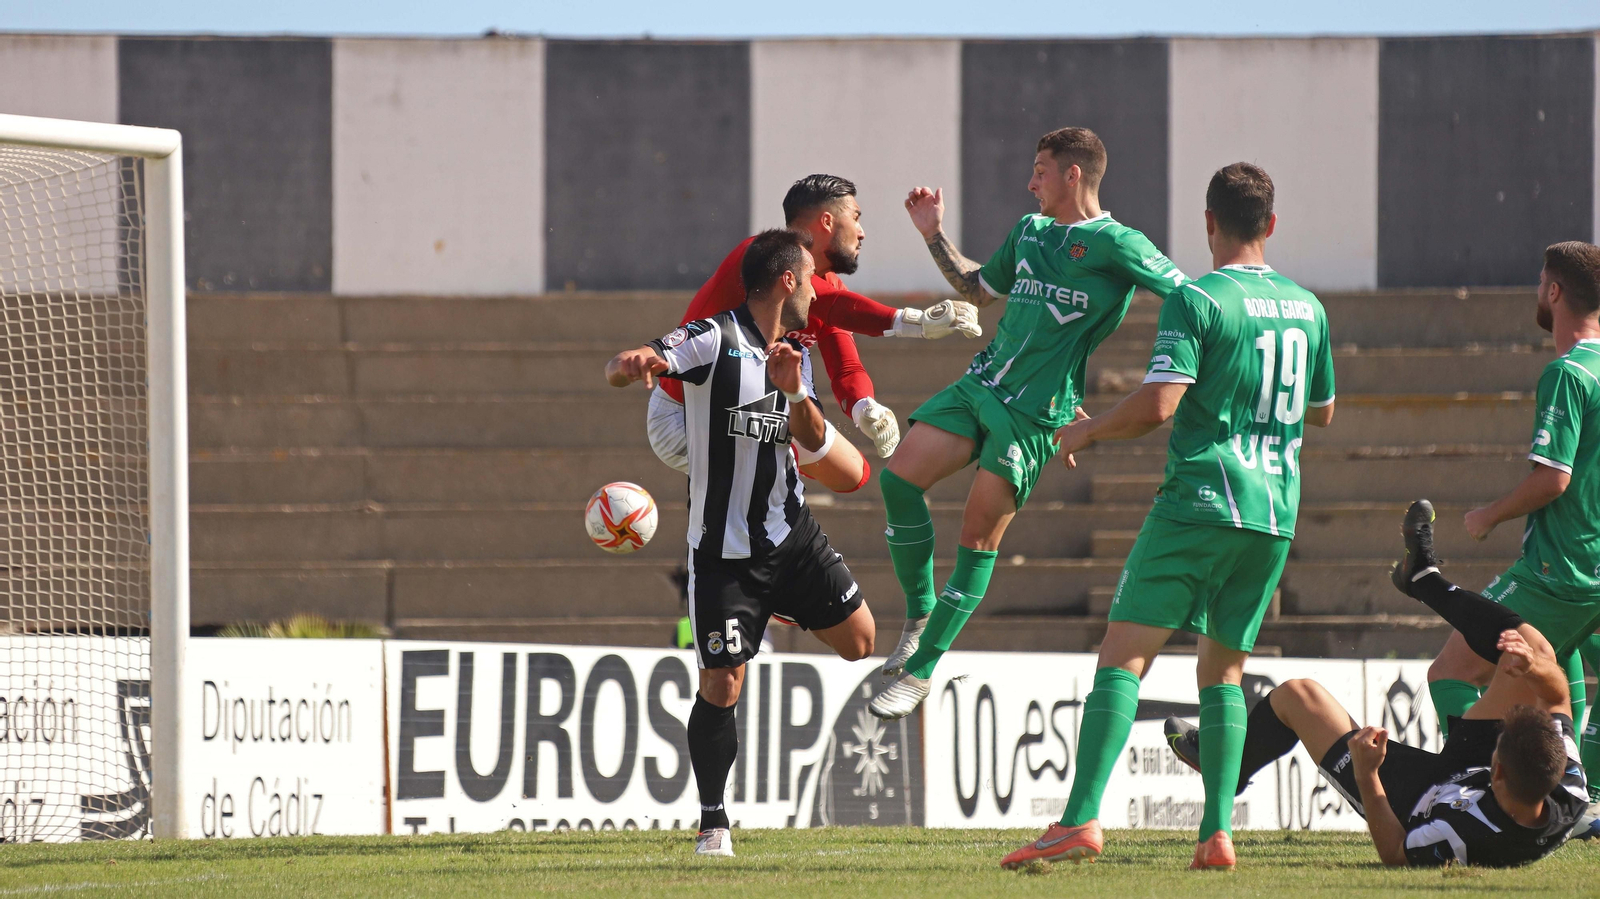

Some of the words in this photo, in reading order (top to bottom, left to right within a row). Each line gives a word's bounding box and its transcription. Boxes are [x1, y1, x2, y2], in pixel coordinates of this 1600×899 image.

[1243, 297, 1280, 319] BORJA
[1255, 328, 1308, 425] 19
[727, 411, 792, 445] LOTU
[725, 617, 742, 655] 5
[203, 680, 352, 754] Diputación
[201, 777, 235, 839] de
[248, 776, 325, 838] Cádiz
